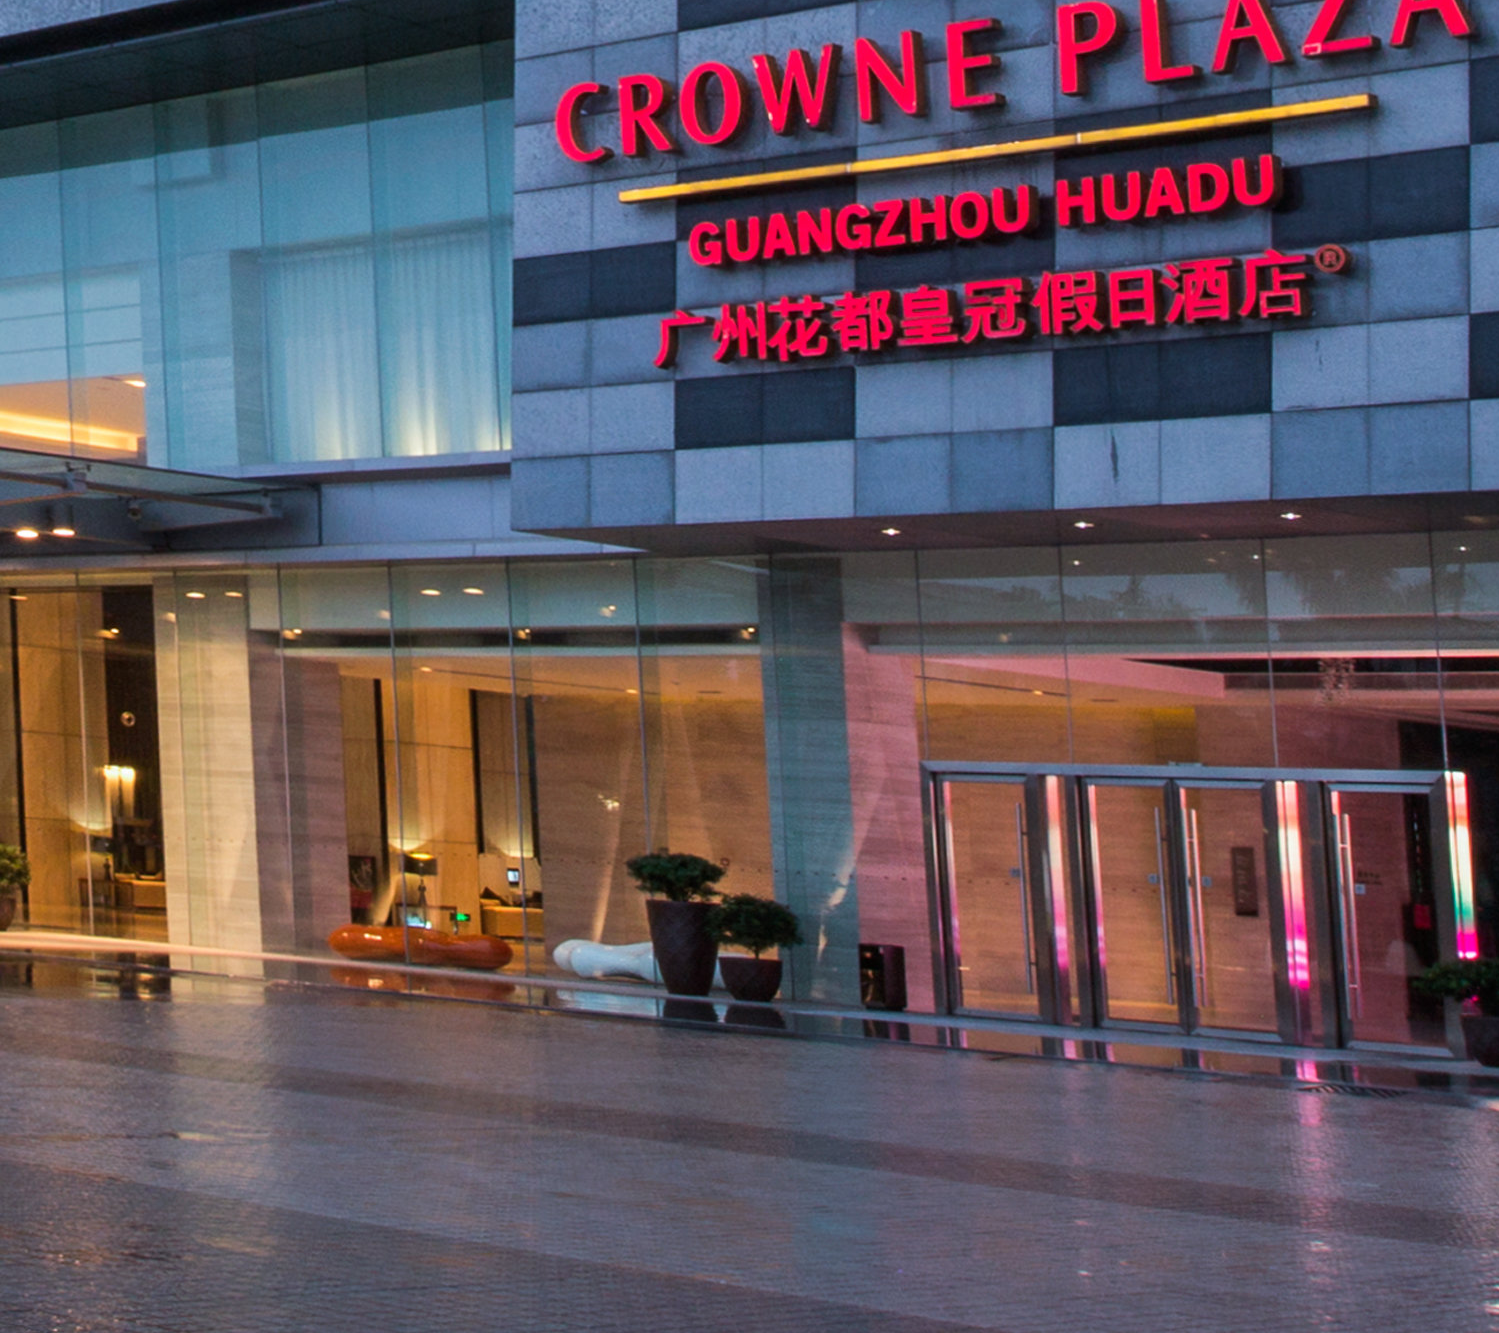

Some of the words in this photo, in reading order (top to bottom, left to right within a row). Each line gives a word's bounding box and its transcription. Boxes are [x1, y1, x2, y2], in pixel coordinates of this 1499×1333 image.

[555, 17, 1000, 163] CROWNE
[688, 184, 1031, 267] GUANGZHOU
[1057, 155, 1276, 226] HUADU
